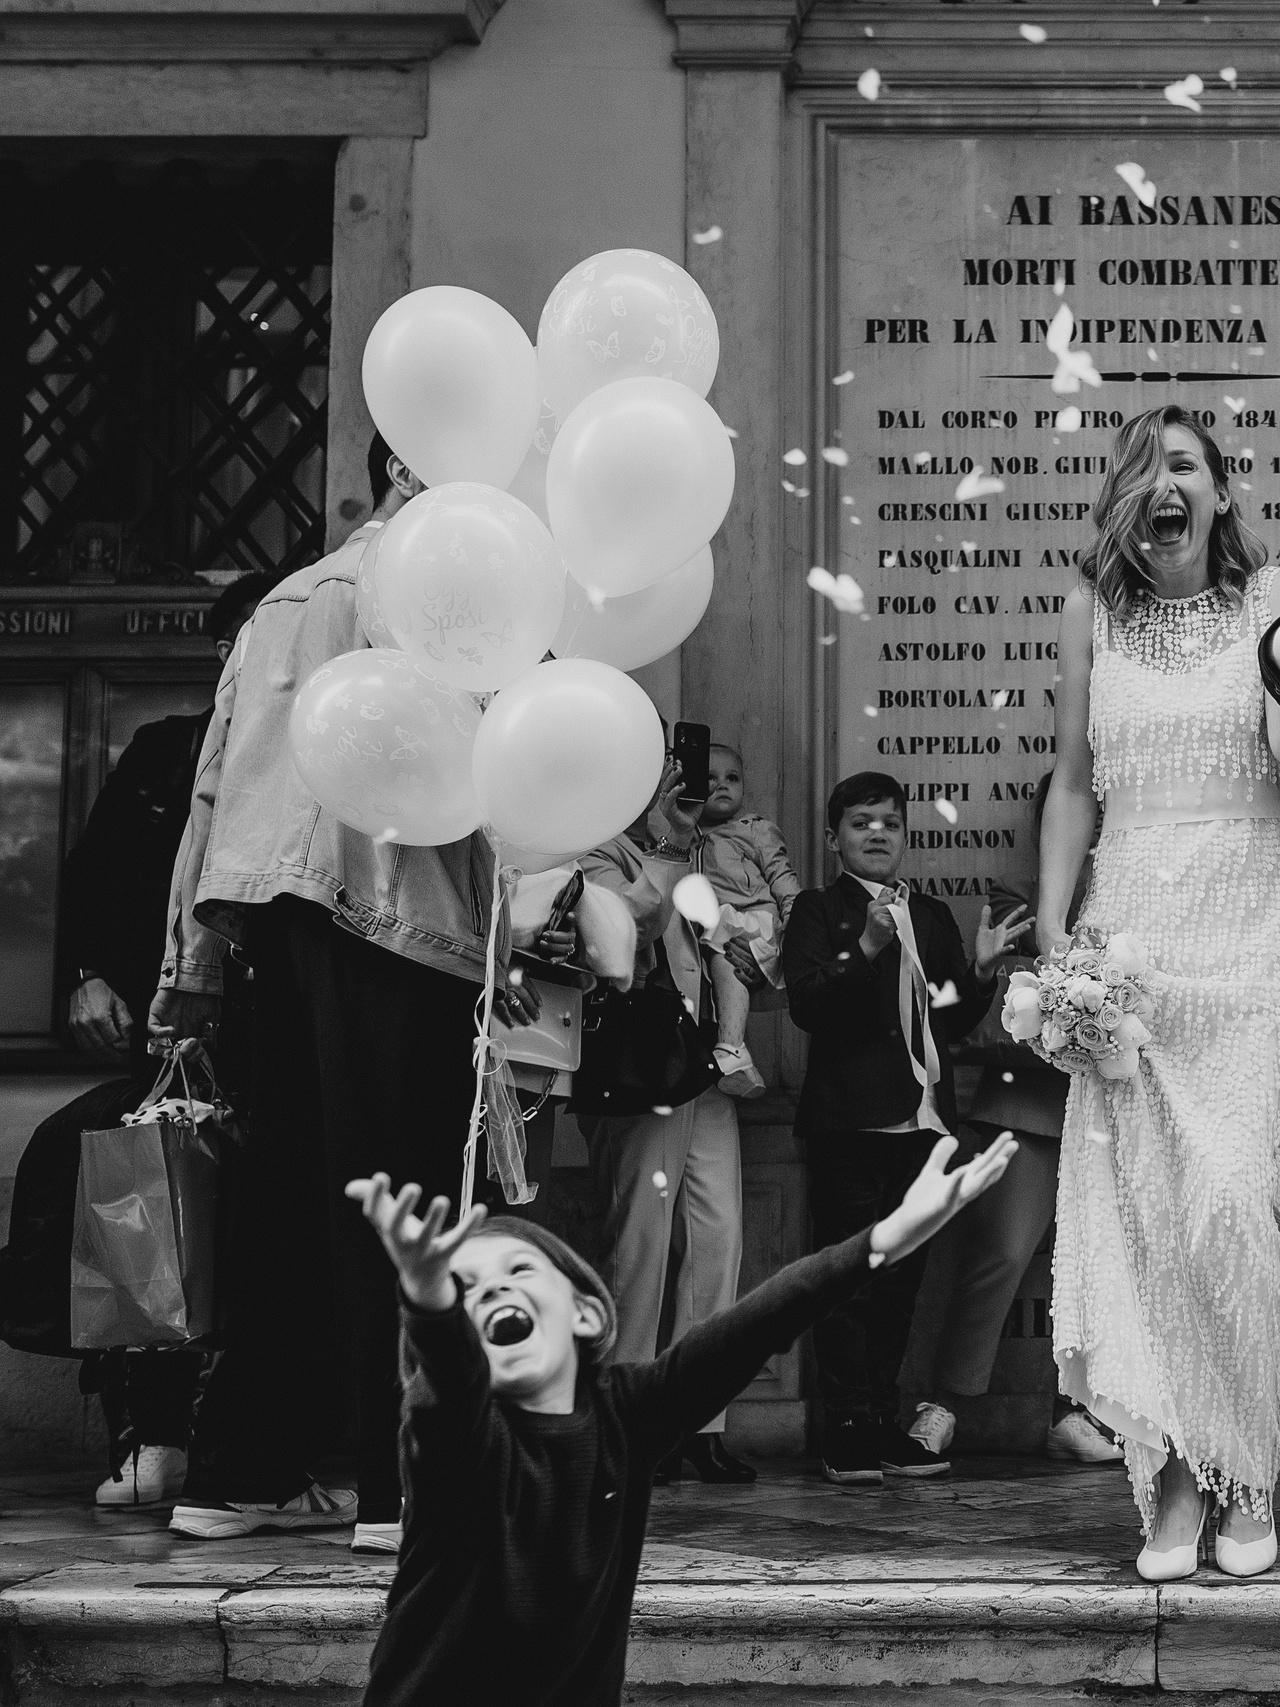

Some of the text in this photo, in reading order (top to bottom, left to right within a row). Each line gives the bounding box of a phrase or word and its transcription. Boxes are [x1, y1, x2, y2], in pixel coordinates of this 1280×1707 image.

[1006, 195, 1053, 225] AI
[961, 258, 1077, 286] MORTI
[864, 318, 931, 344] PER
[952, 318, 998, 344] LA
[878, 410, 926, 429] DAL
[941, 410, 1019, 429] CORNO
[1034, 410, 1125, 429] PITRO
[878, 456, 974, 475] MAELLO
[991, 456, 1048, 475] NOB.
[878, 503, 988, 521] CRESCINI
[878, 549, 1022, 575] PASQUALINI
[877, 596, 937, 614] FOLO
[878, 642, 987, 661] ASTOLFO
[877, 736, 1001, 755] CAPPELLO
[902, 783, 970, 801] LIPPI
[908, 829, 1016, 849] RDIGNON
